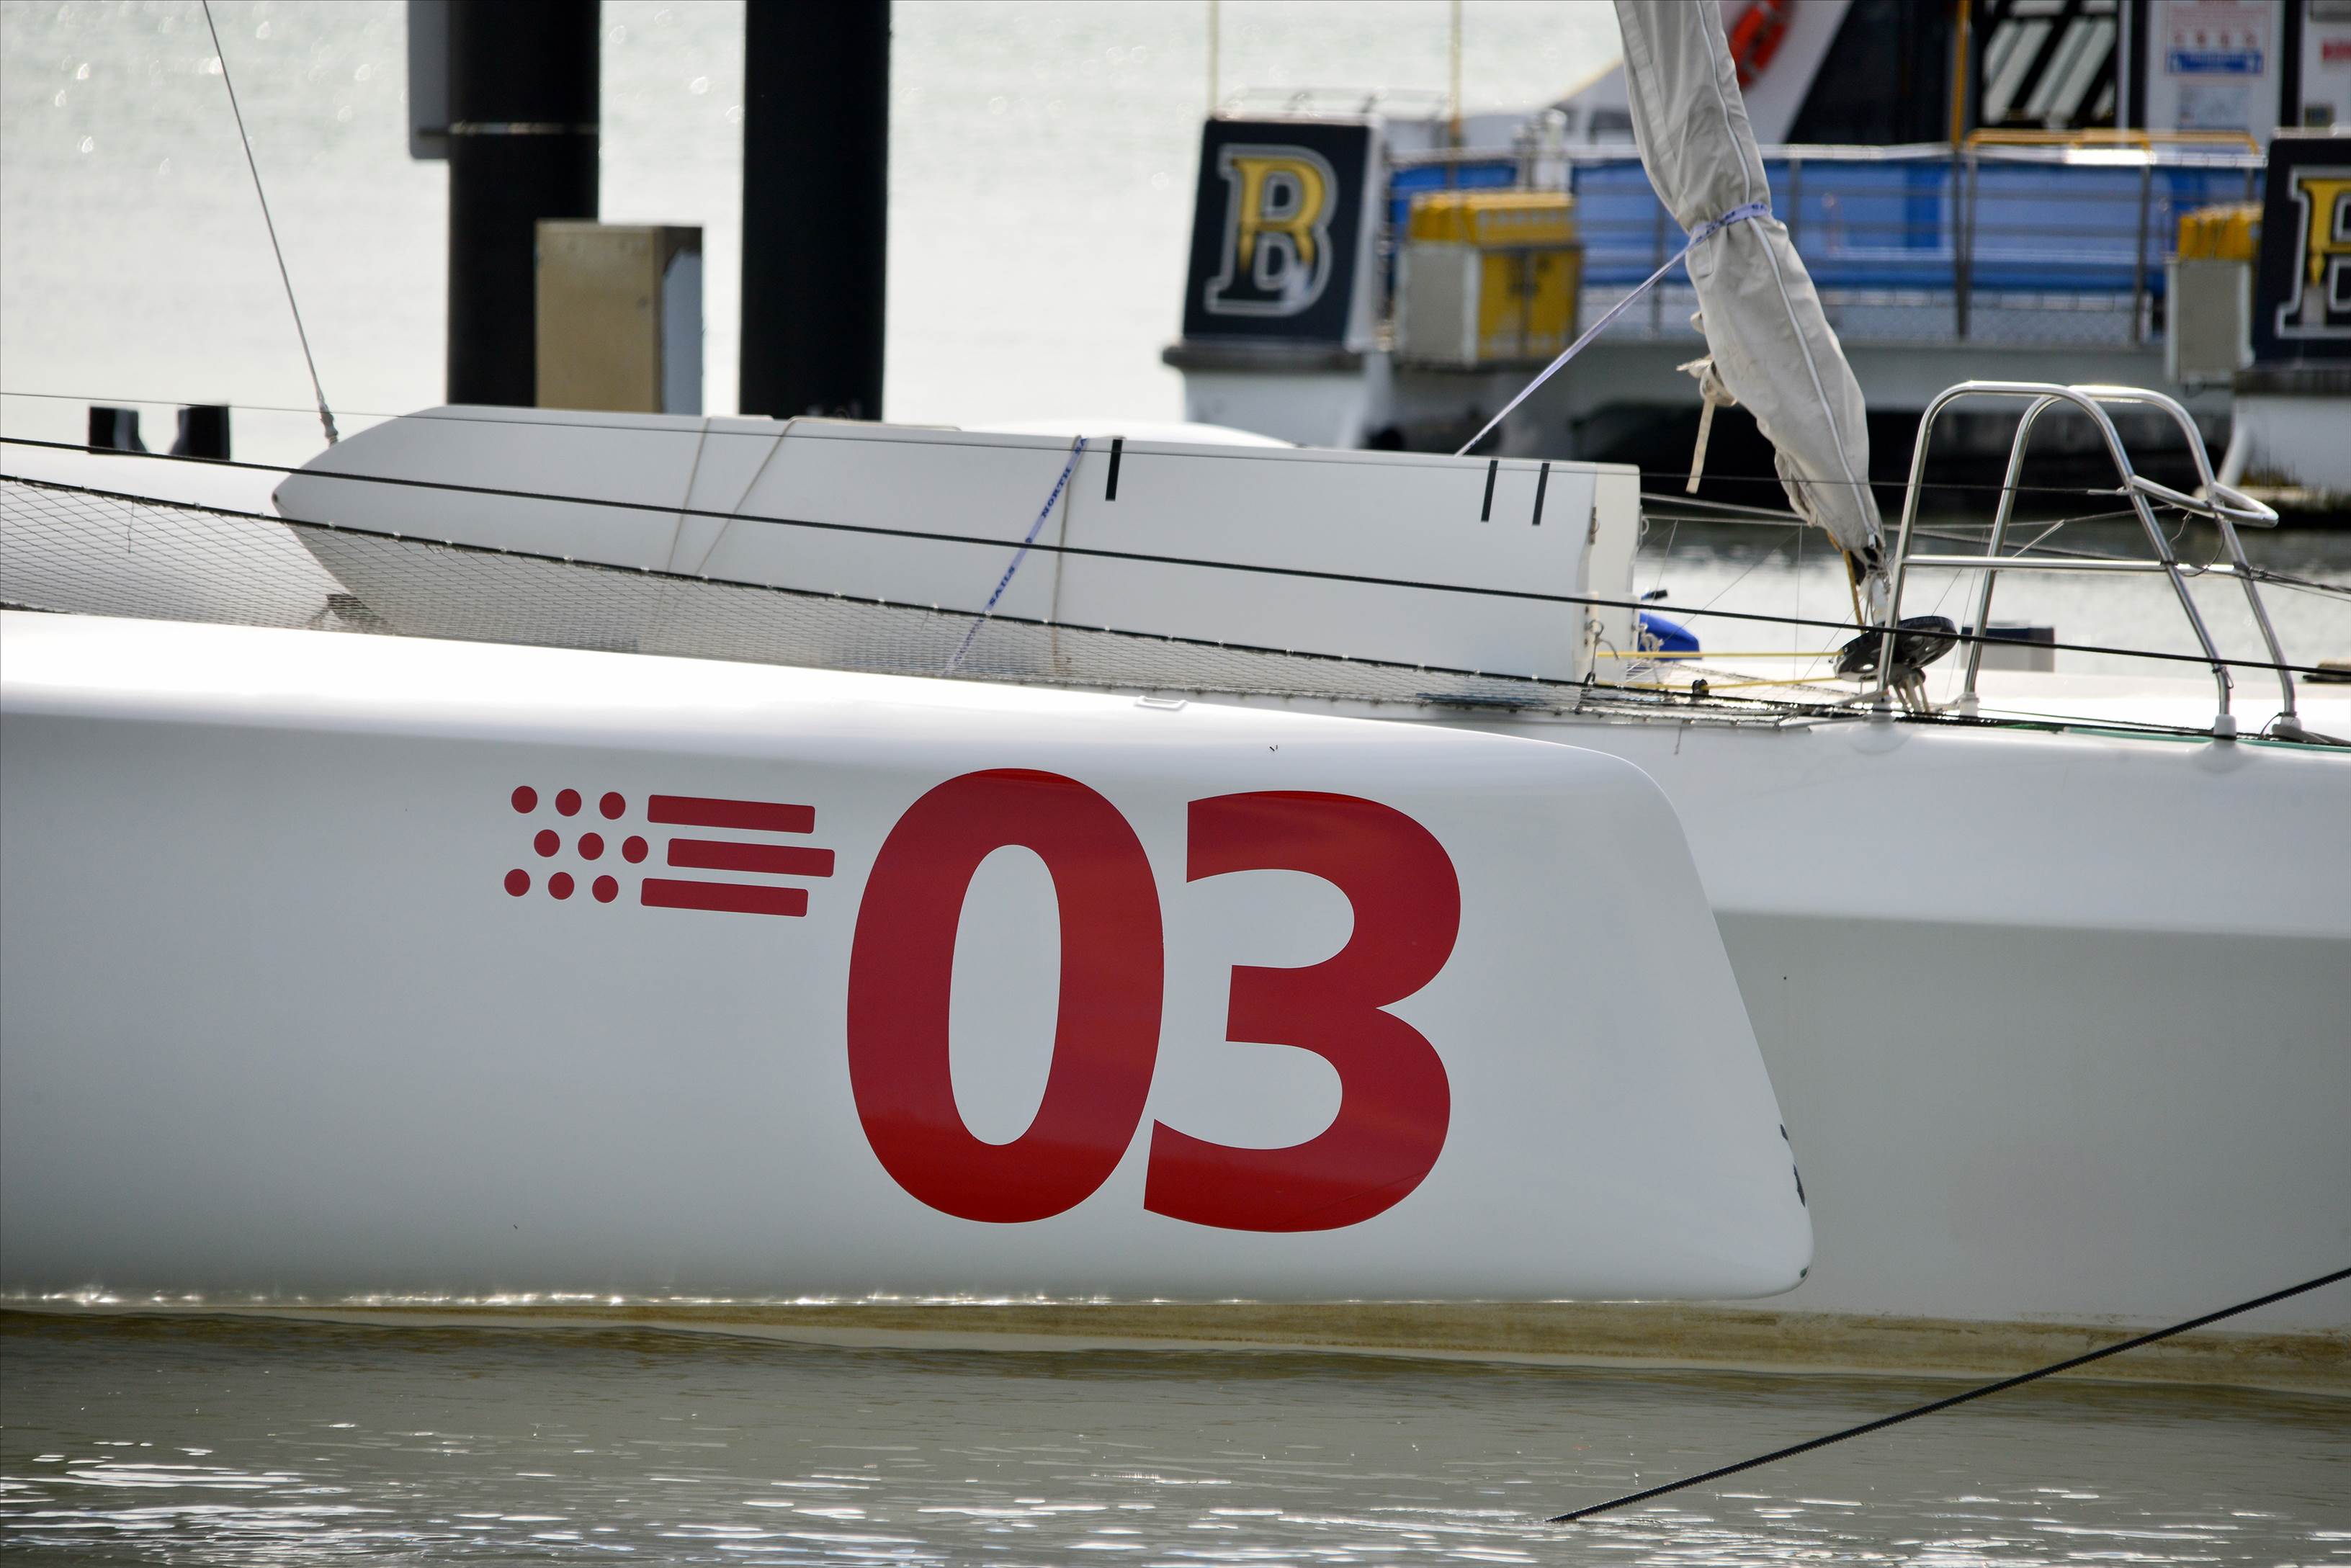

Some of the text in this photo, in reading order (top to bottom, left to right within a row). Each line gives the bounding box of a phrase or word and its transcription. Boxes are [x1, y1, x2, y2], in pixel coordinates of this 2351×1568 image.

[1204, 143, 1338, 315] B
[989, 565, 1015, 606] SAILS
[1041, 467, 1072, 519] NORTH
[847, 768, 1461, 1232] 03
